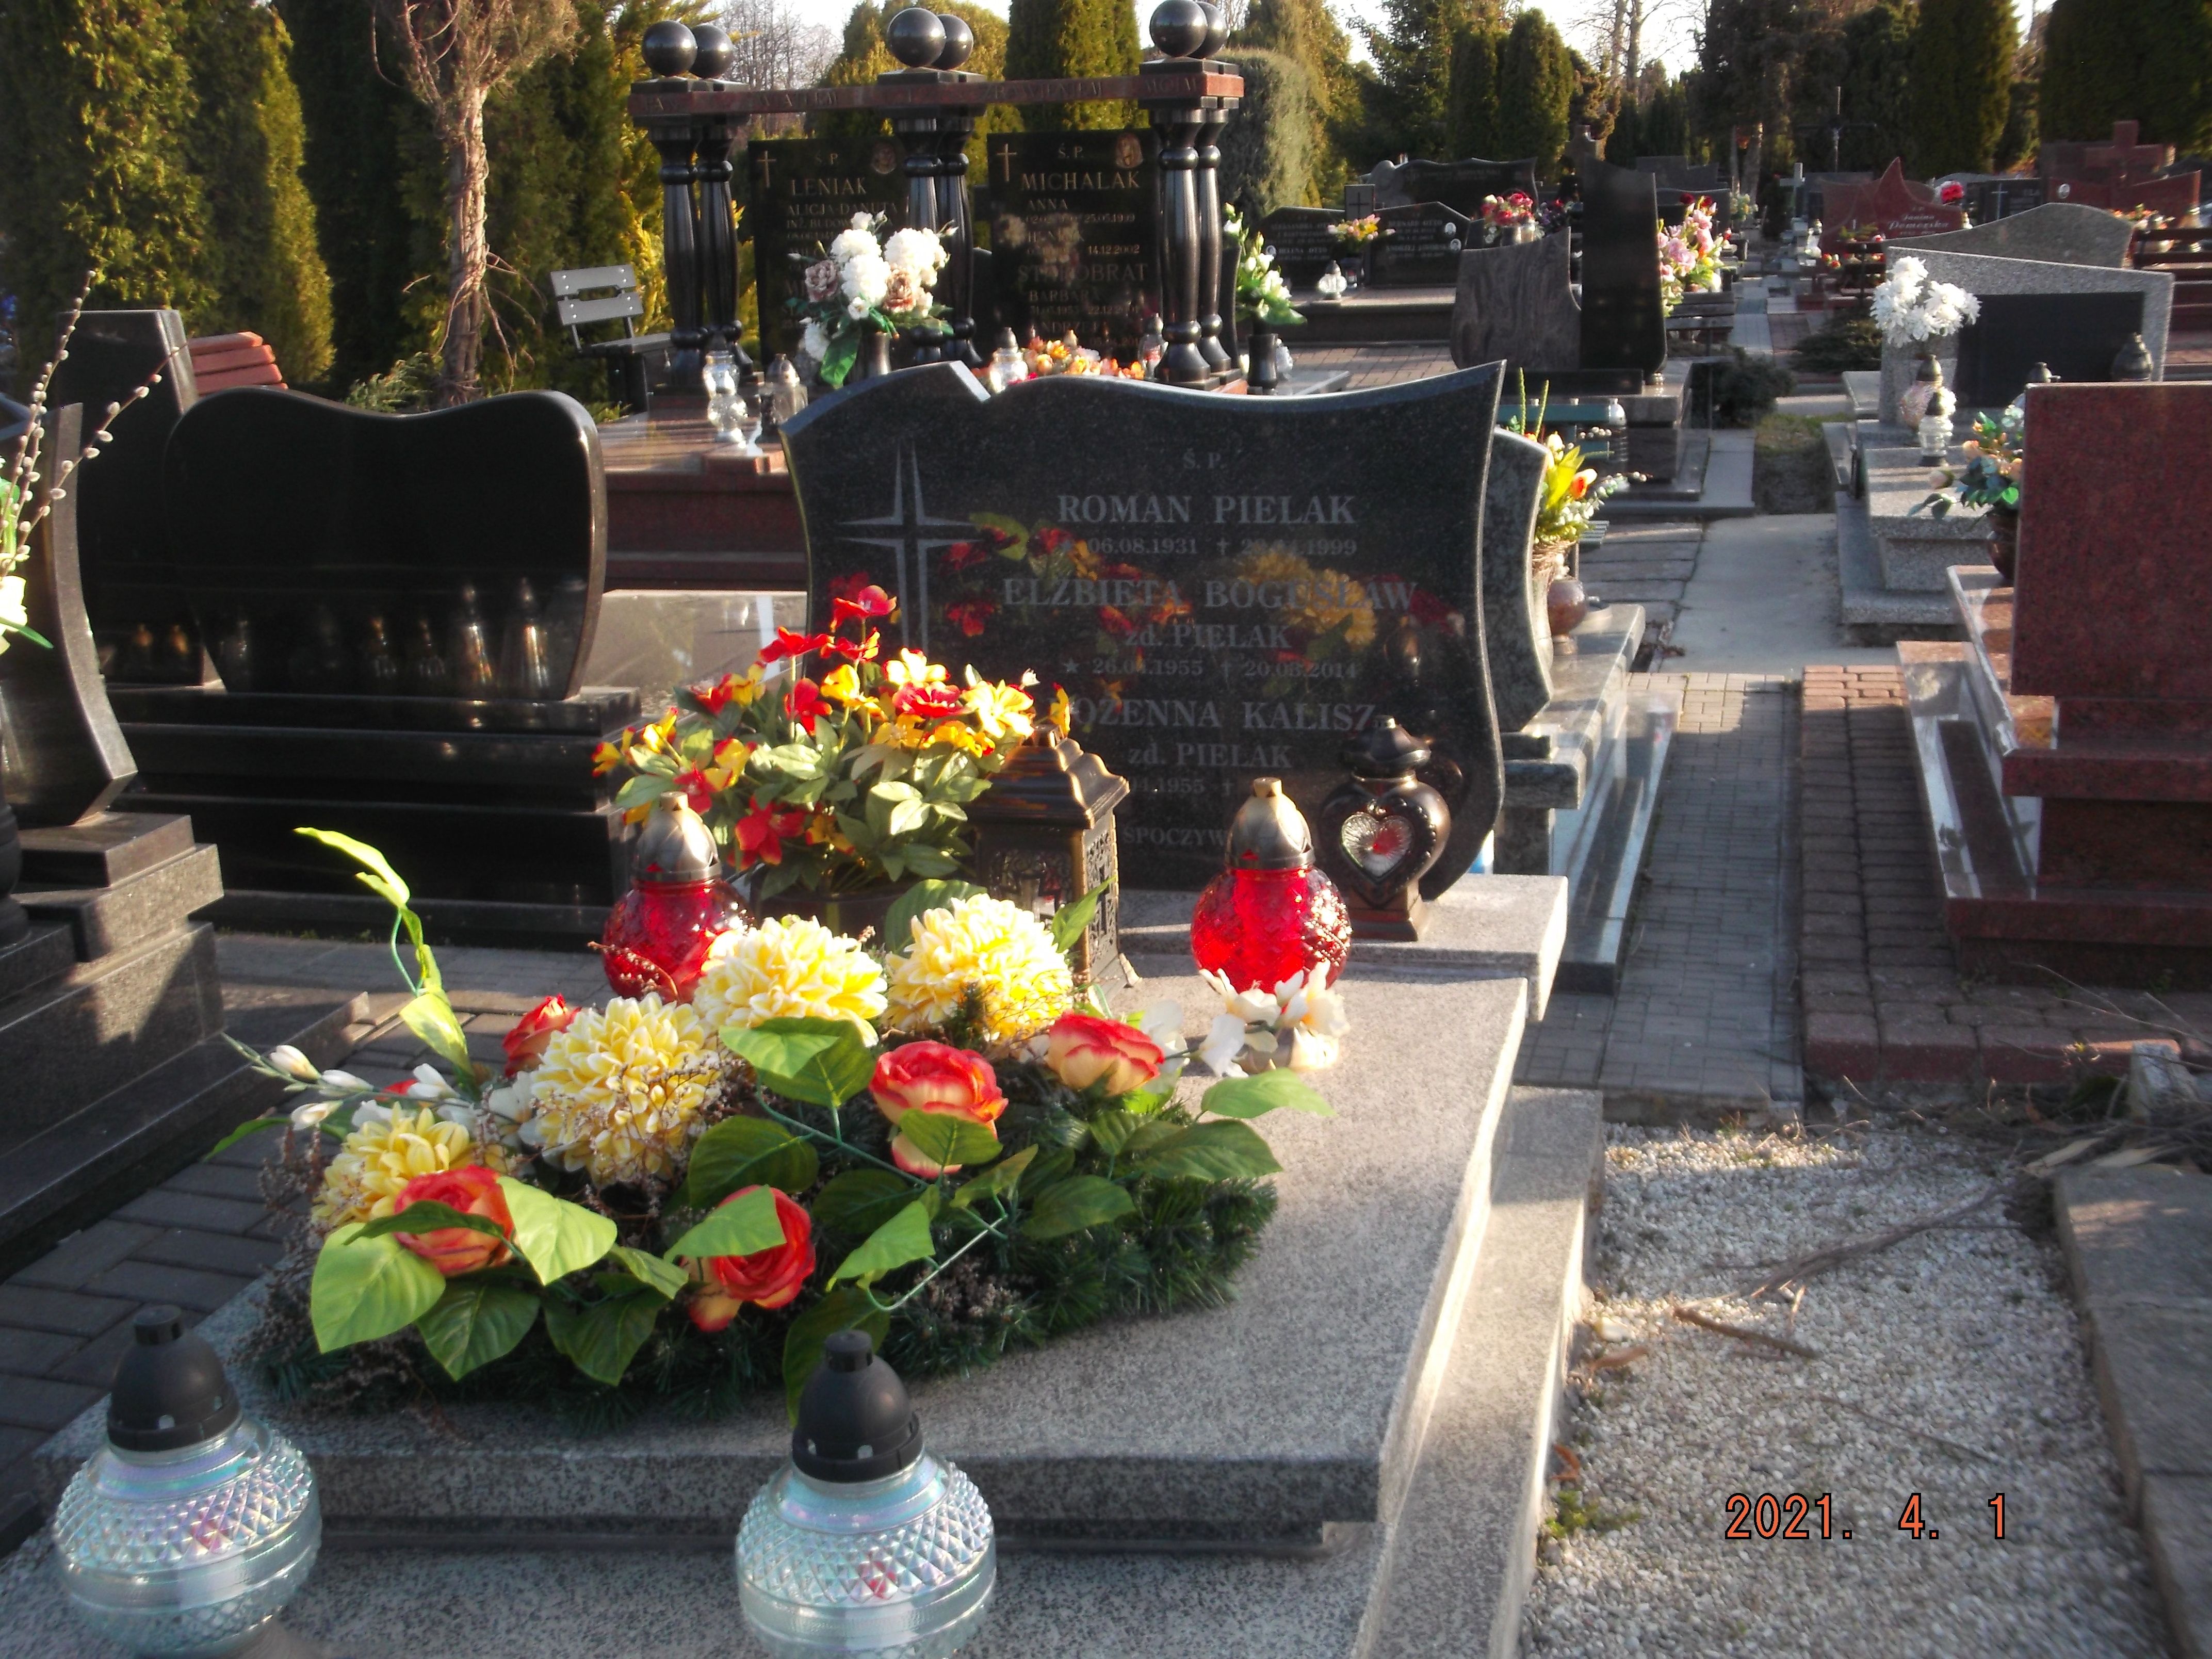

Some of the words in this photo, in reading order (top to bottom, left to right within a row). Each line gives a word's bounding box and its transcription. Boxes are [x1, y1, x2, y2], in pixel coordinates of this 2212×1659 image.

[790, 177, 867, 197] LENIAK
[1020, 170, 1141, 191] MICHALAK
[1027, 198, 1068, 211] ANNA
[1088, 243, 1141, 255] 14.12.2002
[1058, 494, 1193, 524] ROMAN
[1212, 494, 1357, 525] PIELAK
[1087, 537, 1198, 555] 06.08.1931
[1125, 624, 1163, 646] zd.
[1173, 624, 1292, 649] PIELAK
[1128, 742, 1167, 765] zd.
[1176, 742, 1292, 768] PIELAK
[1122, 826, 1226, 847] SPOCZYW
